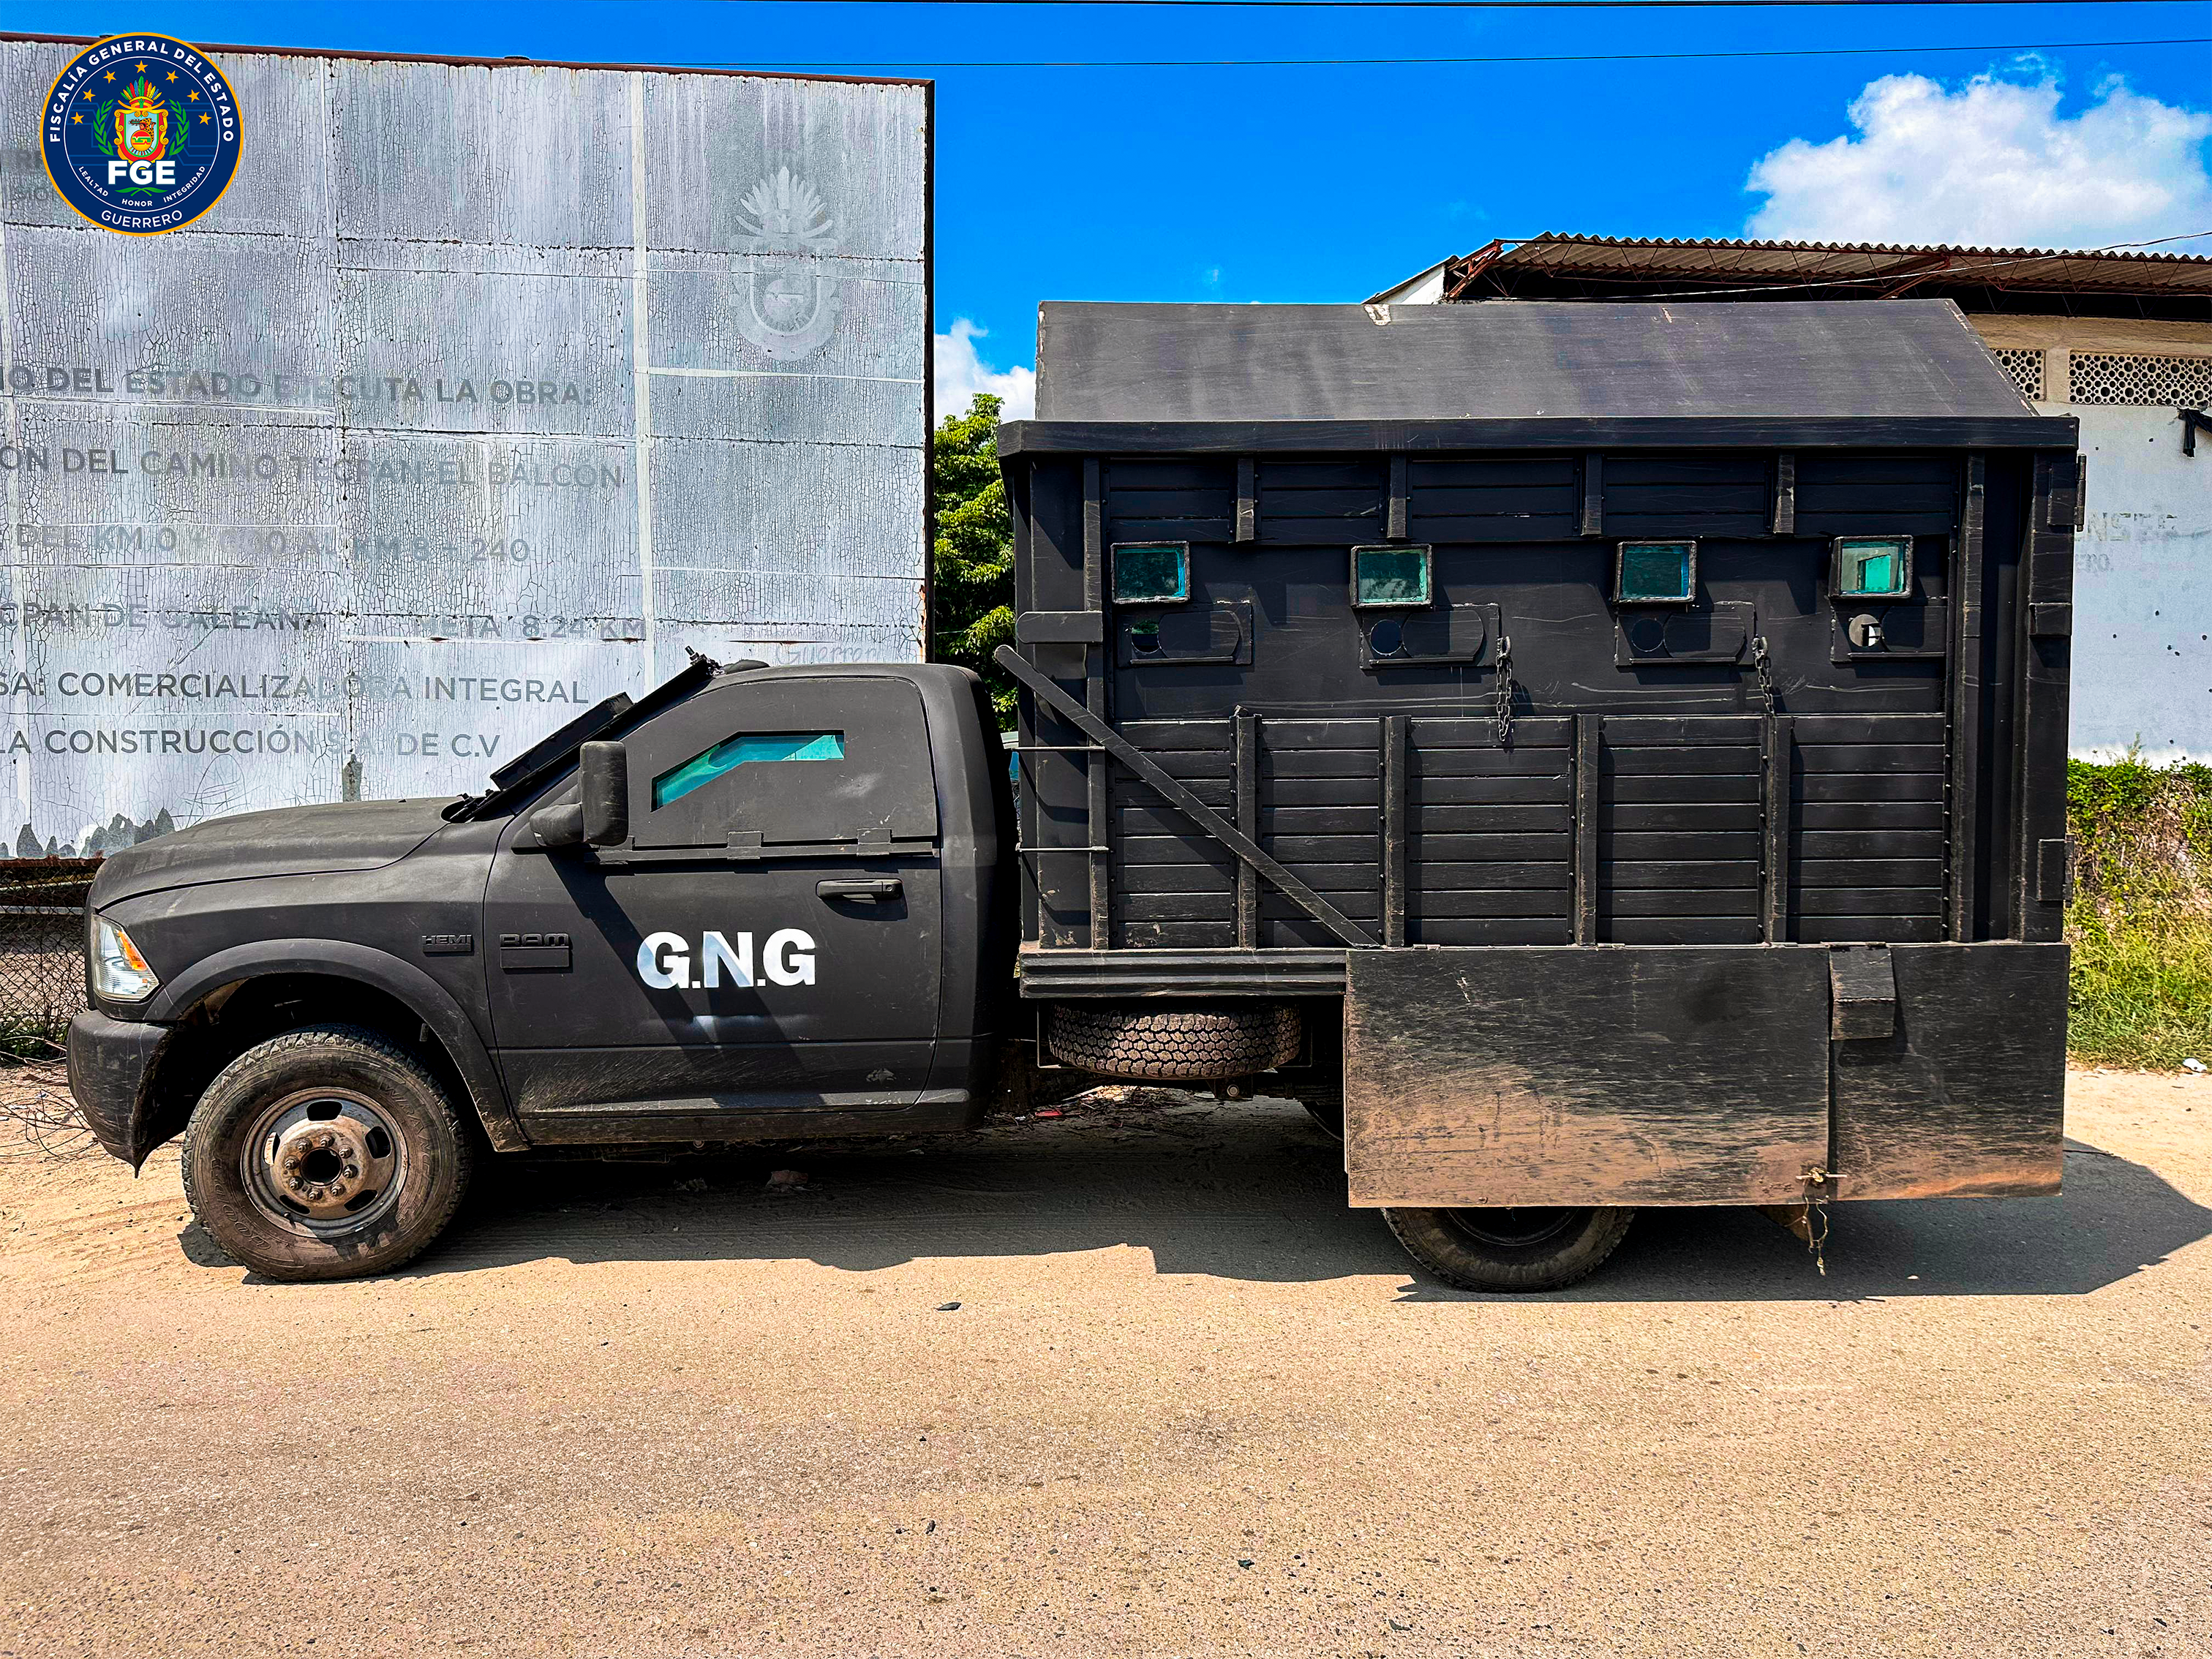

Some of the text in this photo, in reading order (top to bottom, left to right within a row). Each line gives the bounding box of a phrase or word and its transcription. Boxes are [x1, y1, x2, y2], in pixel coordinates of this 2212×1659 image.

[47, 368, 113, 393] DEL
[127, 372, 261, 398] ESTADO
[274, 375, 424, 402] EJECUTA
[437, 378, 478, 403] LA
[490, 380, 592, 405] OBRA:
[64, 448, 128, 474] DEL
[140, 451, 279, 479] CAMINO
[18, 524, 80, 548] DEL
[96, 526, 143, 550] KM
[354, 535, 400, 561] KM
[470, 539, 530, 563] 240
[103, 603, 146, 628] DE
[163, 605, 323, 631] GALEANA
[600, 620, 645, 639] KM
[58, 672, 413, 700] COMERCIALIZADORA
[425, 676, 590, 704] INTEGRAL
[45, 723, 315, 754] CONSTRUCCIÓN
[398, 732, 439, 756] DE
[451, 734, 500, 758] C.V
[422, 935, 472, 945] HEMI
[500, 933, 569, 947] RAM
[637, 928, 816, 989] G.N.G
